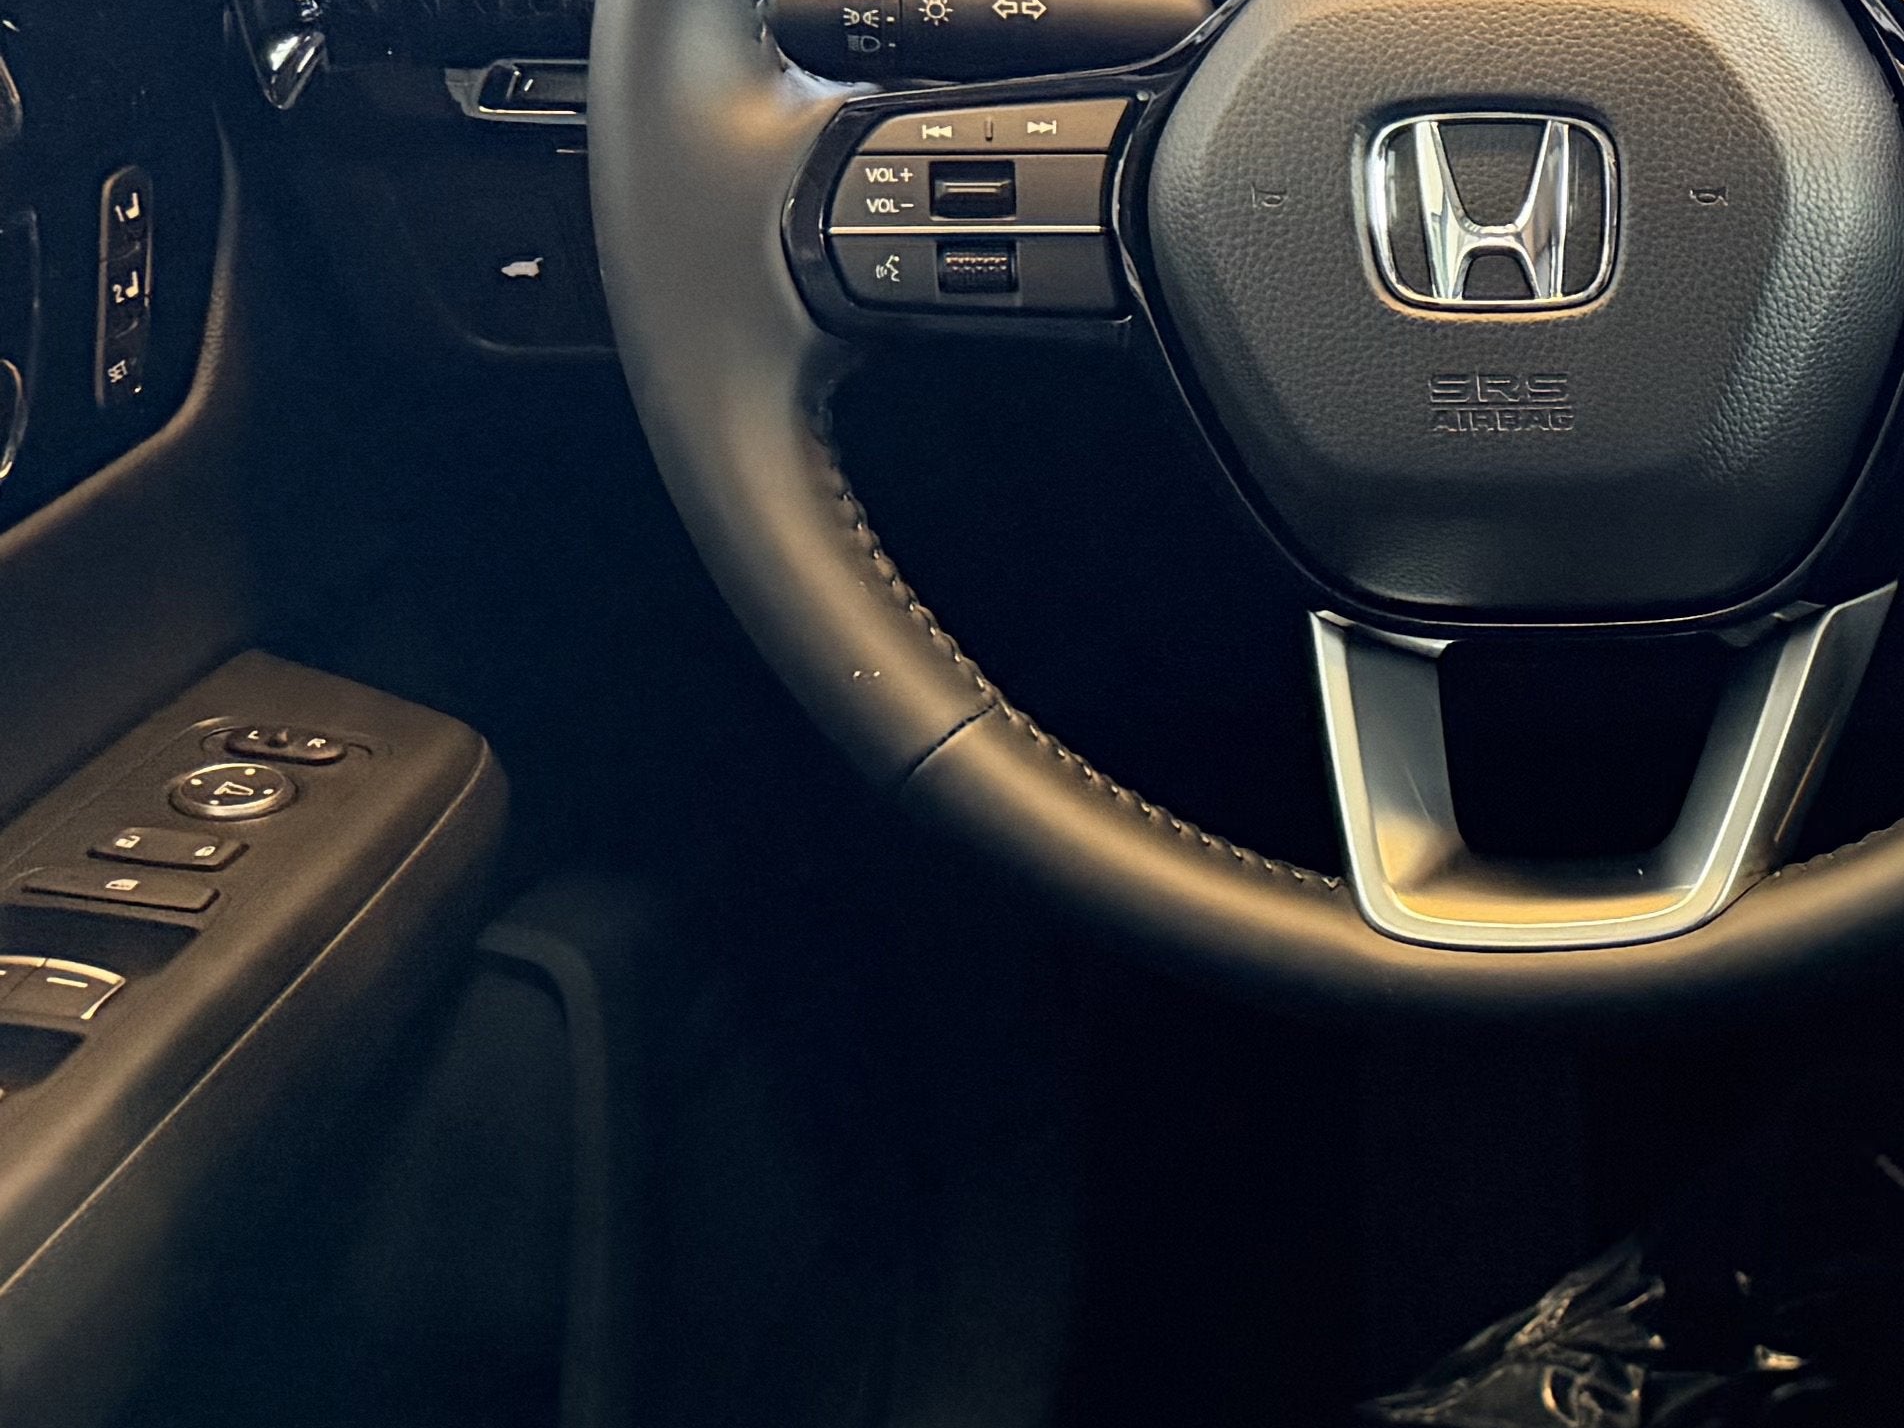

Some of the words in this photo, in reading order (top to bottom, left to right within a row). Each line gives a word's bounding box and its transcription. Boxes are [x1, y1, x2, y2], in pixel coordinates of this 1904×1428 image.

[112, 283, 125, 304] 2
[107, 359, 128, 383] SET
[1428, 373, 1569, 403] SRS
[1432, 410, 1574, 432] AIRBAG
